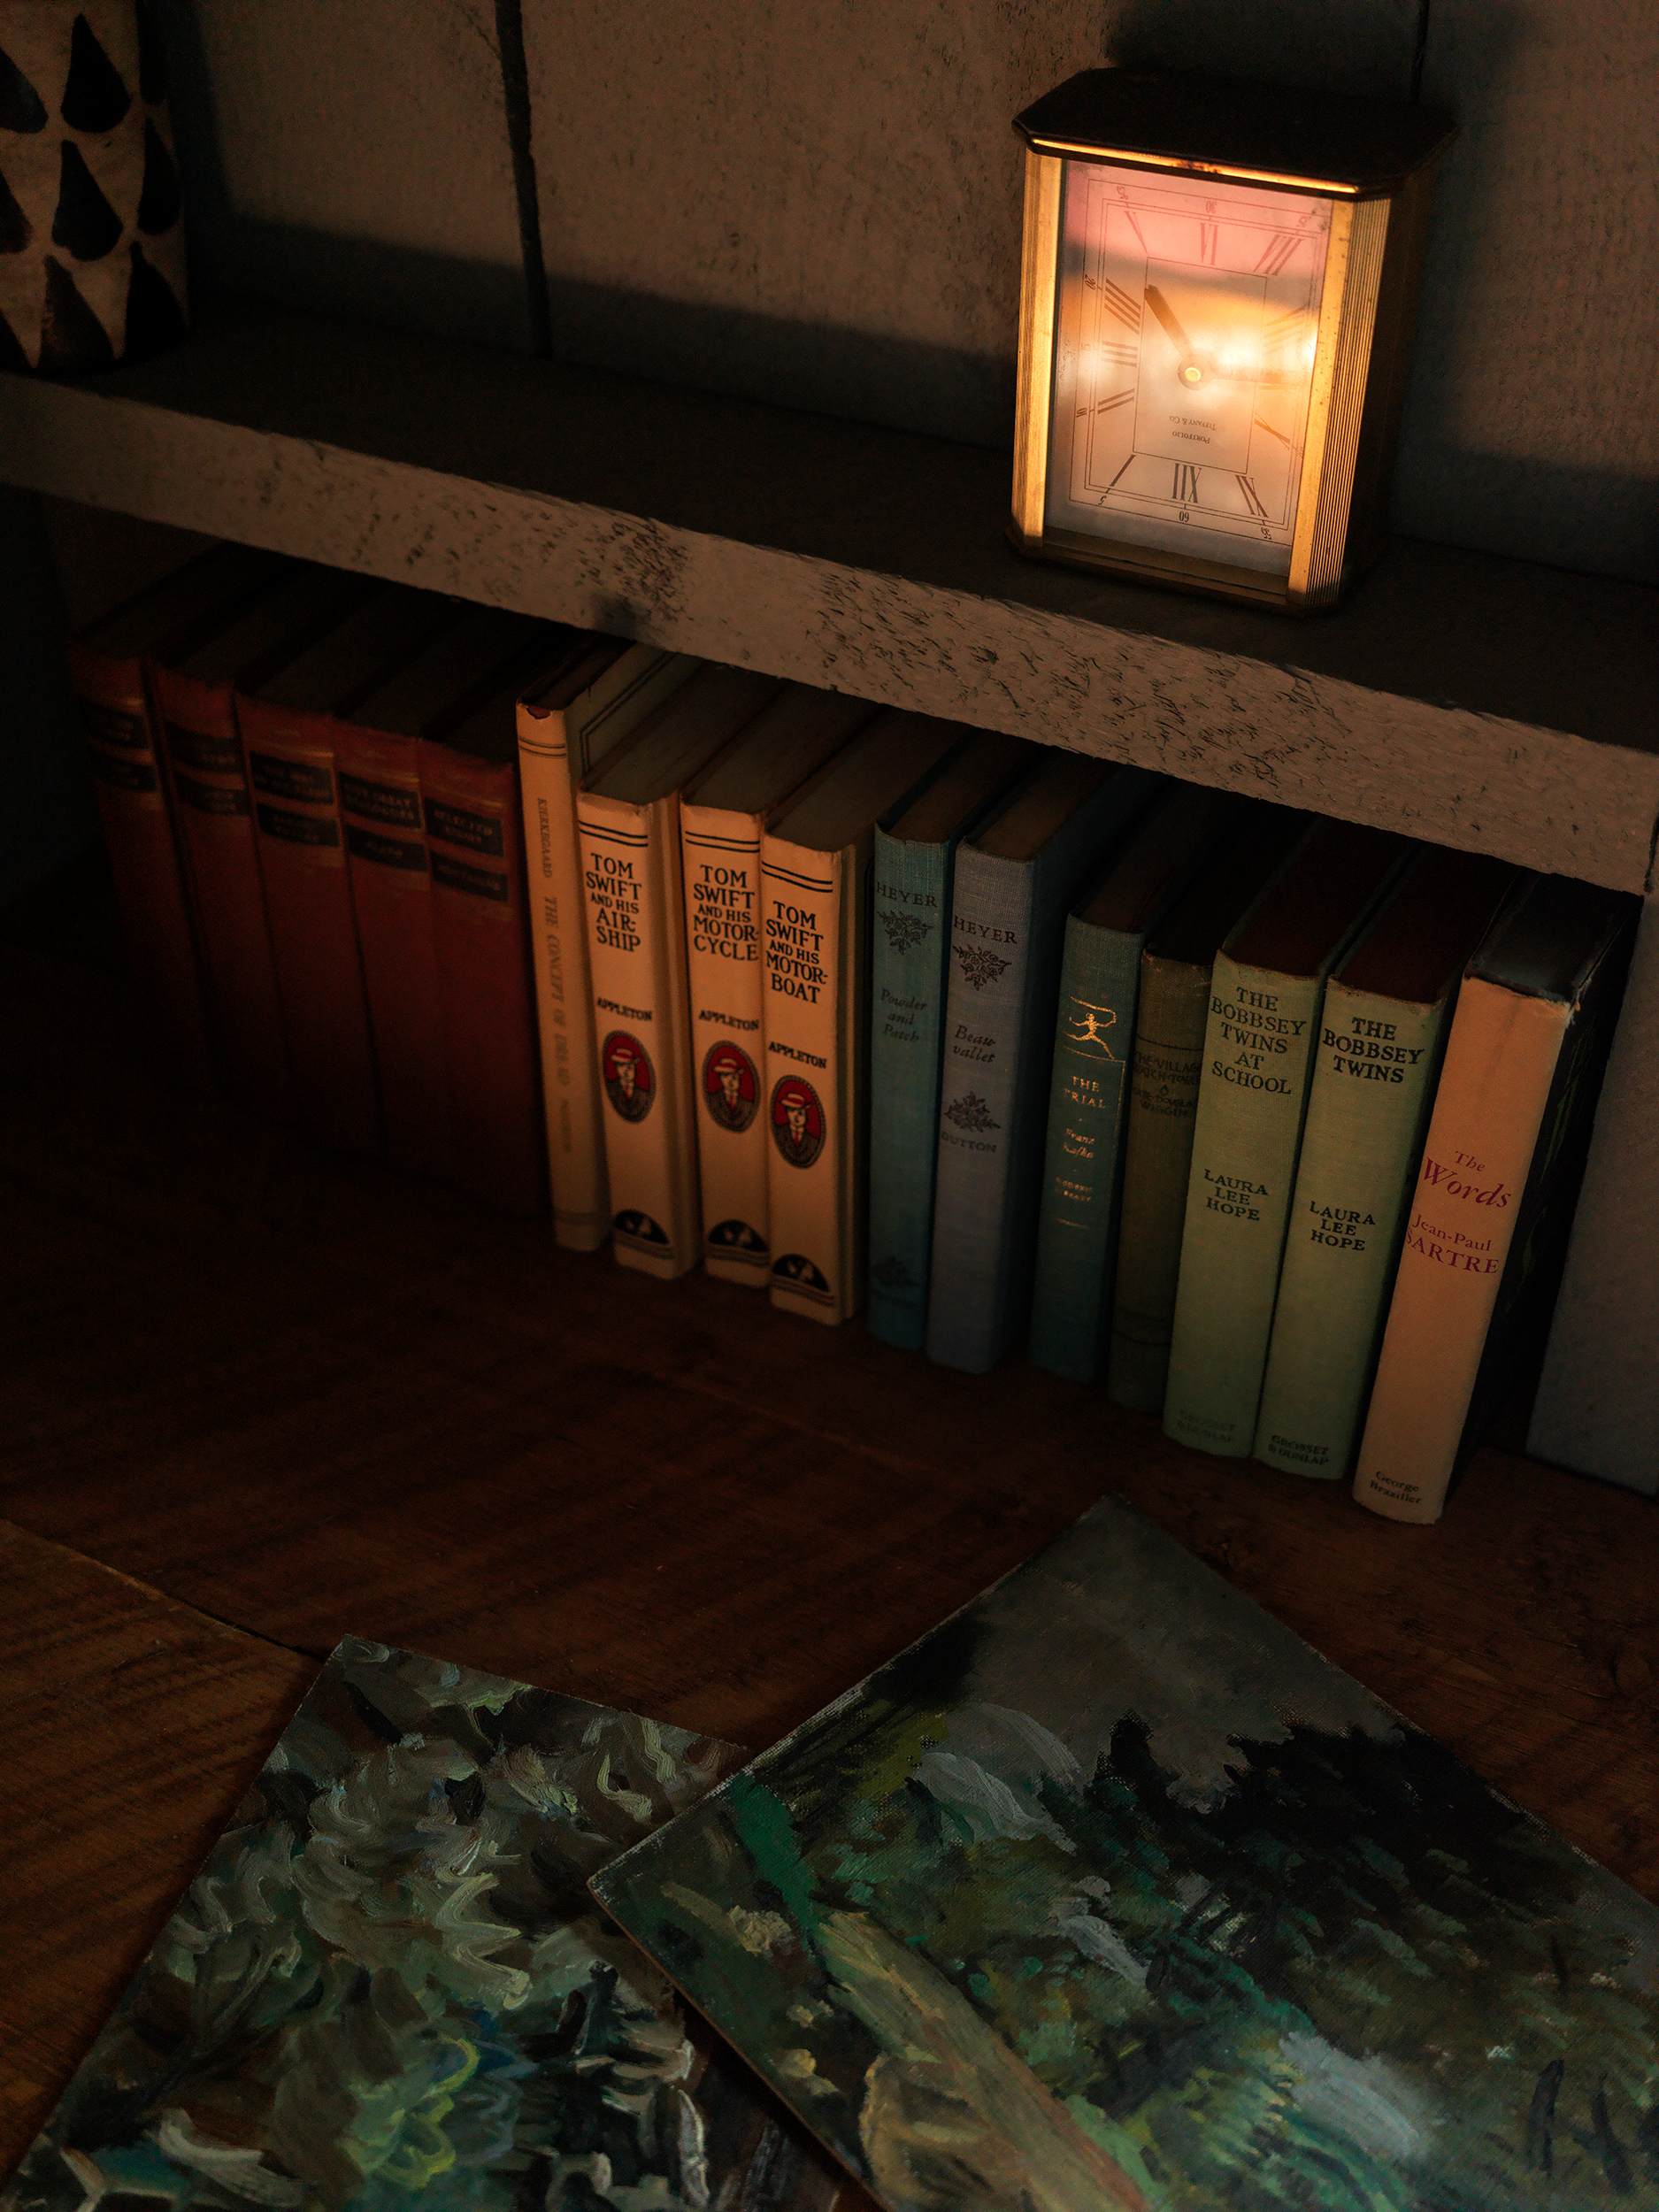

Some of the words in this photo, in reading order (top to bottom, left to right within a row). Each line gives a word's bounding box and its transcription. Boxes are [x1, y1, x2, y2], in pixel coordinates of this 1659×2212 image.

[1171, 463, 1202, 503] XII
[1178, 511, 1190, 524] 60
[590, 852, 634, 879] TOM
[700, 864, 748, 888] TOM
[586, 872, 642, 901] SWIFT
[694, 884, 756, 909] SWIFT
[876, 880, 938, 909] HEYER
[543, 895, 559, 929] THE
[591, 892, 613, 909] AND
[615, 899, 640, 914] HIS
[698, 904, 723, 919] AND
[726, 909, 751, 923] HIS
[596, 908, 636, 932] AIR-
[773, 901, 817, 931] TOM
[596, 926, 641, 952] SHIP
[766, 919, 824, 951] SWIFT
[954, 918, 1018, 944] HEYER
[694, 934, 759, 961] CYCLE
[769, 940, 794, 956] AND
[796, 948, 819, 964] HIS
[766, 950, 828, 985] MOTOR-
[772, 973, 820, 1004] BOAT
[880, 988, 928, 1012] Powder
[1236, 986, 1279, 1011] THE
[597, 997, 652, 1021] APPLETON
[699, 1010, 759, 1031] APPLETON
[887, 1010, 916, 1026] and
[1210, 995, 1307, 1036] BOBBSEY
[882, 1024, 921, 1043] Patch
[1220, 1021, 1288, 1055] TWINS
[1352, 1017, 1397, 1041] THE
[769, 1041, 827, 1069] APPLETON
[952, 1044, 996, 1064] vallet
[1323, 1029, 1425, 1065] BOBBSEY
[1234, 1051, 1265, 1070] AT
[1333, 1055, 1404, 1084] TWINS
[1071, 1074, 1101, 1093] THE
[1211, 1061, 1292, 1095] SCHOOL
[1064, 1088, 1107, 1110] TRIAL
[941, 1131, 998, 1153] DUTTON
[1454, 1150, 1486, 1172] The
[1204, 1169, 1269, 1196] LAURA
[1423, 1157, 1512, 1210] Words
[1215, 1186, 1251, 1206] LEE
[1206, 1197, 1261, 1222] HOPE
[1310, 1201, 1376, 1226] LAURA
[1320, 1218, 1356, 1237] LEE
[1412, 1214, 1494, 1252] Jean-Paul
[1311, 1230, 1366, 1252] HOPE
[1404, 1233, 1500, 1275] SARTRE
[1370, 1479, 1423, 1504] Braziller
[1375, 1470, 1419, 1493] George
